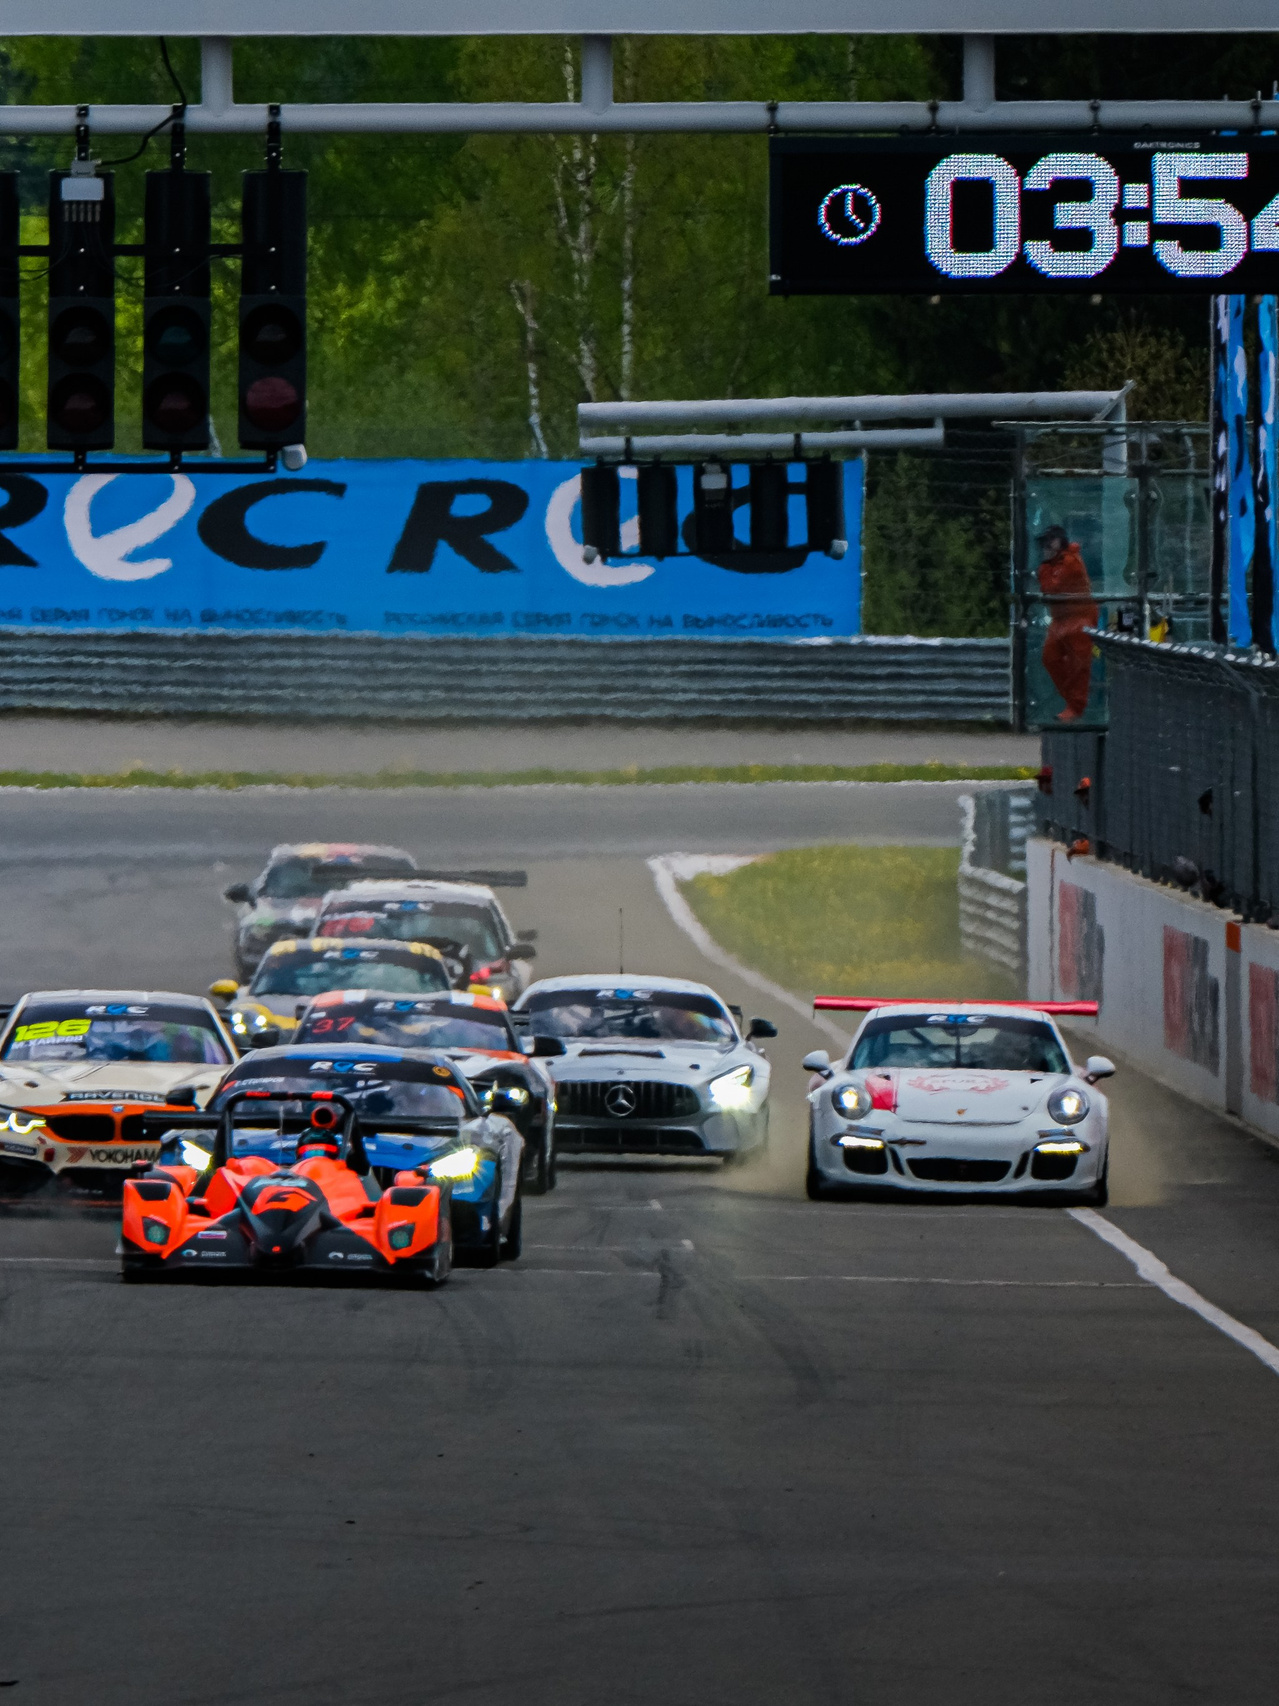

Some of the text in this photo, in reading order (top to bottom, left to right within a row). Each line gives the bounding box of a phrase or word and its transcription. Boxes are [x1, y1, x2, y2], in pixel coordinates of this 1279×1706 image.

[925, 153, 1279, 277] 03:5
[15, 1019, 91, 1042] 126
[312, 1017, 355, 1033] 37
